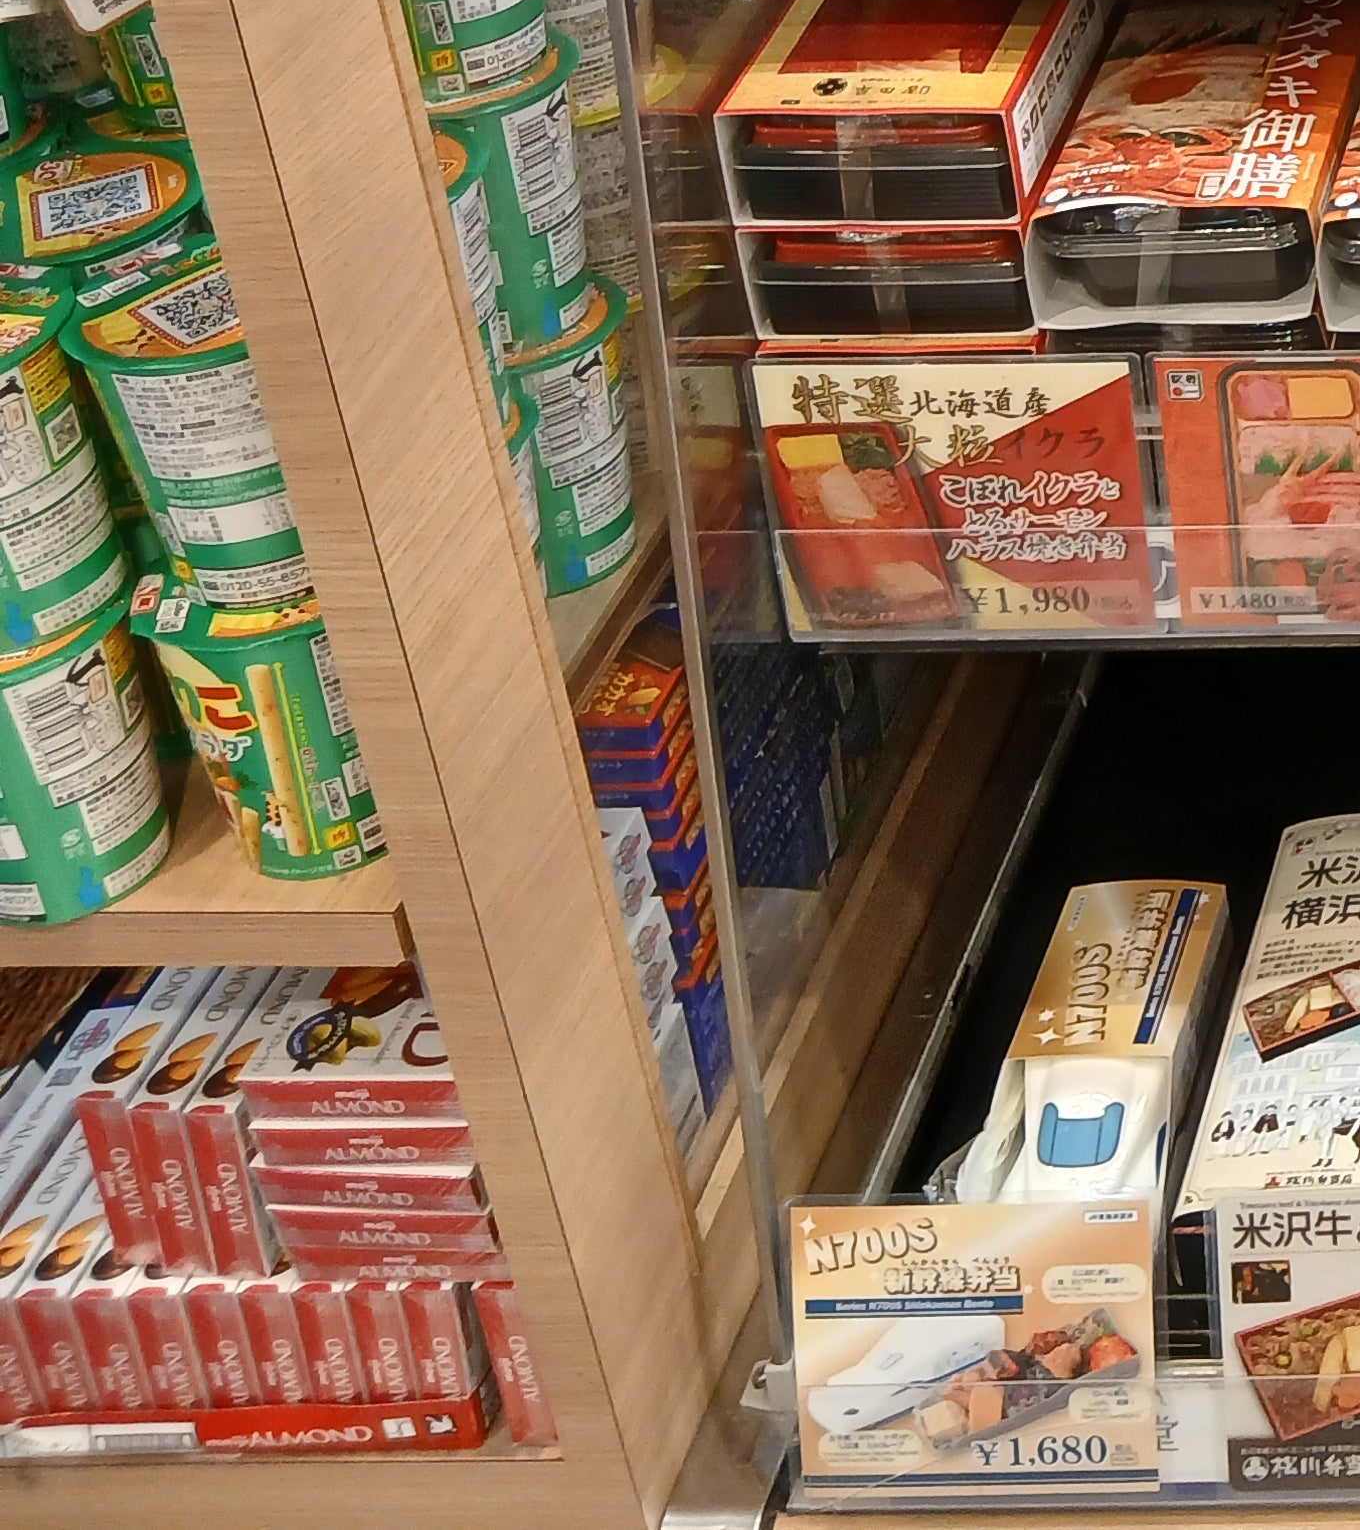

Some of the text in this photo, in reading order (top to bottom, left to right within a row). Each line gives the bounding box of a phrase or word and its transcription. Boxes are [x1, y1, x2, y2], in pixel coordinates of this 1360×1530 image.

[791, 373, 1051, 423] 特選北海道産
[895, 425, 1106, 469] 大粒イクラ
[938, 469, 1121, 507] こぼれイクラと
[963, 509, 1108, 535] とろサーモン
[945, 534, 1127, 563] ハラス焼き弁当
[963, 587, 1090, 617] ¥1,980
[1064, 942, 1111, 1047] N700S
[311, 1098, 405, 1116] ALMOND
[324, 1144, 420, 1162] ALMOND
[109, 1147, 146, 1220] ALMOND
[216, 1161, 249, 1235] ALMOND
[804, 1217, 939, 1276] N700S
[359, 1263, 452, 1279] ALMOND
[248, 1425, 374, 1447] ALMOND
[972, 1435, 1108, 1467] ¥1,680
